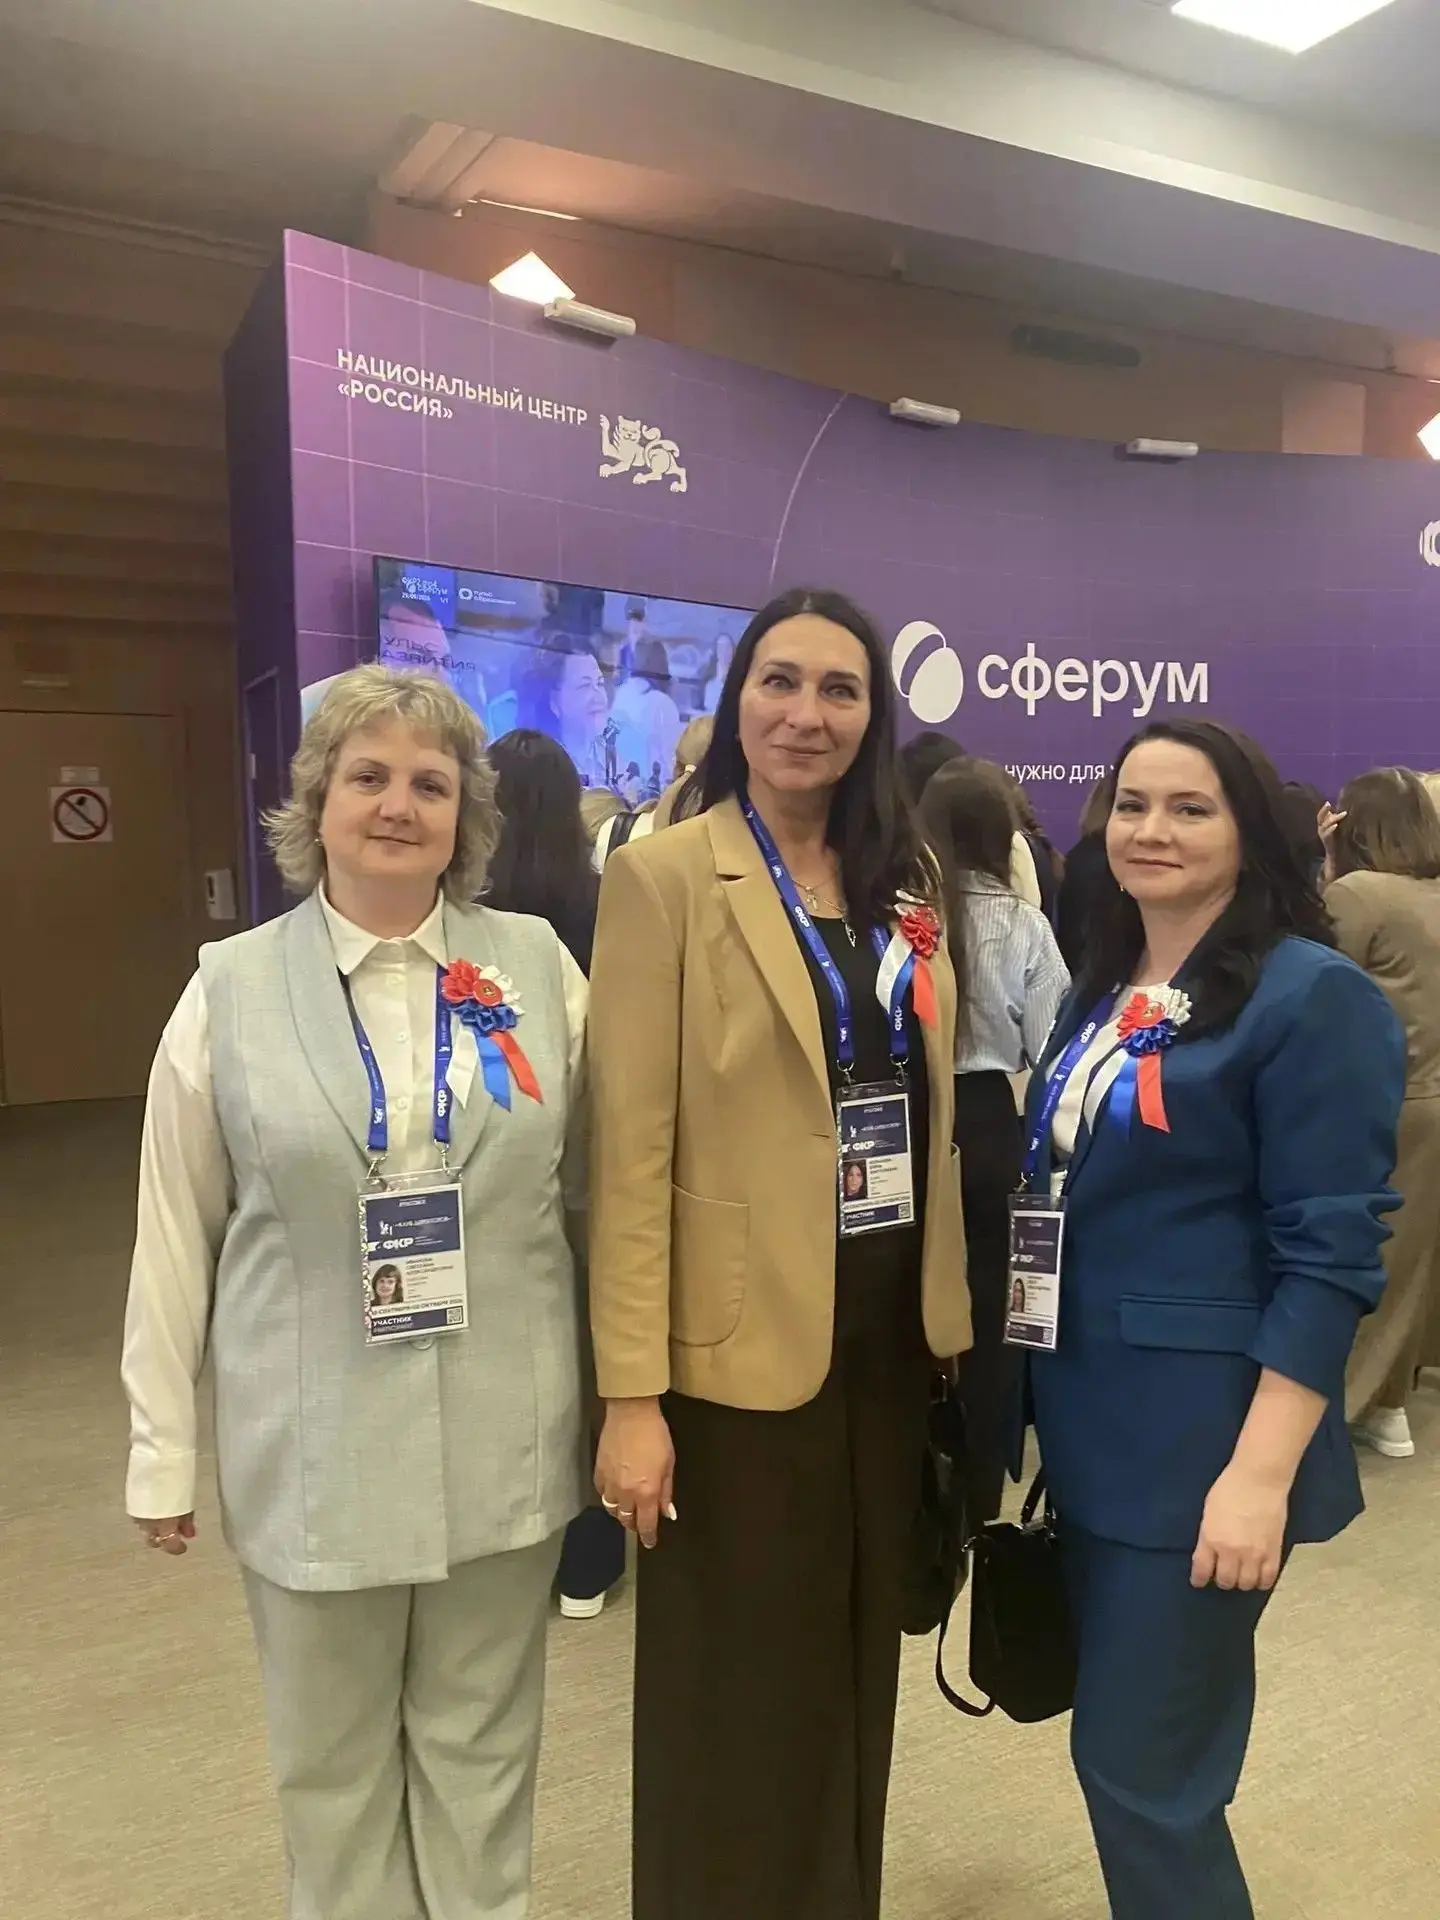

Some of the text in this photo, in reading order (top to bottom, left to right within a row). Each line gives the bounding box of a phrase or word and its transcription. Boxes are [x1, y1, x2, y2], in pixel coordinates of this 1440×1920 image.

[337, 348, 588, 425] НАЦИОНАЛЬНЫЙ ЦЕНТР
[337, 379, 453, 419] «РОССИЯ»
[977, 642, 1209, 717] сферум
[1004, 764, 1105, 784] нужно для
